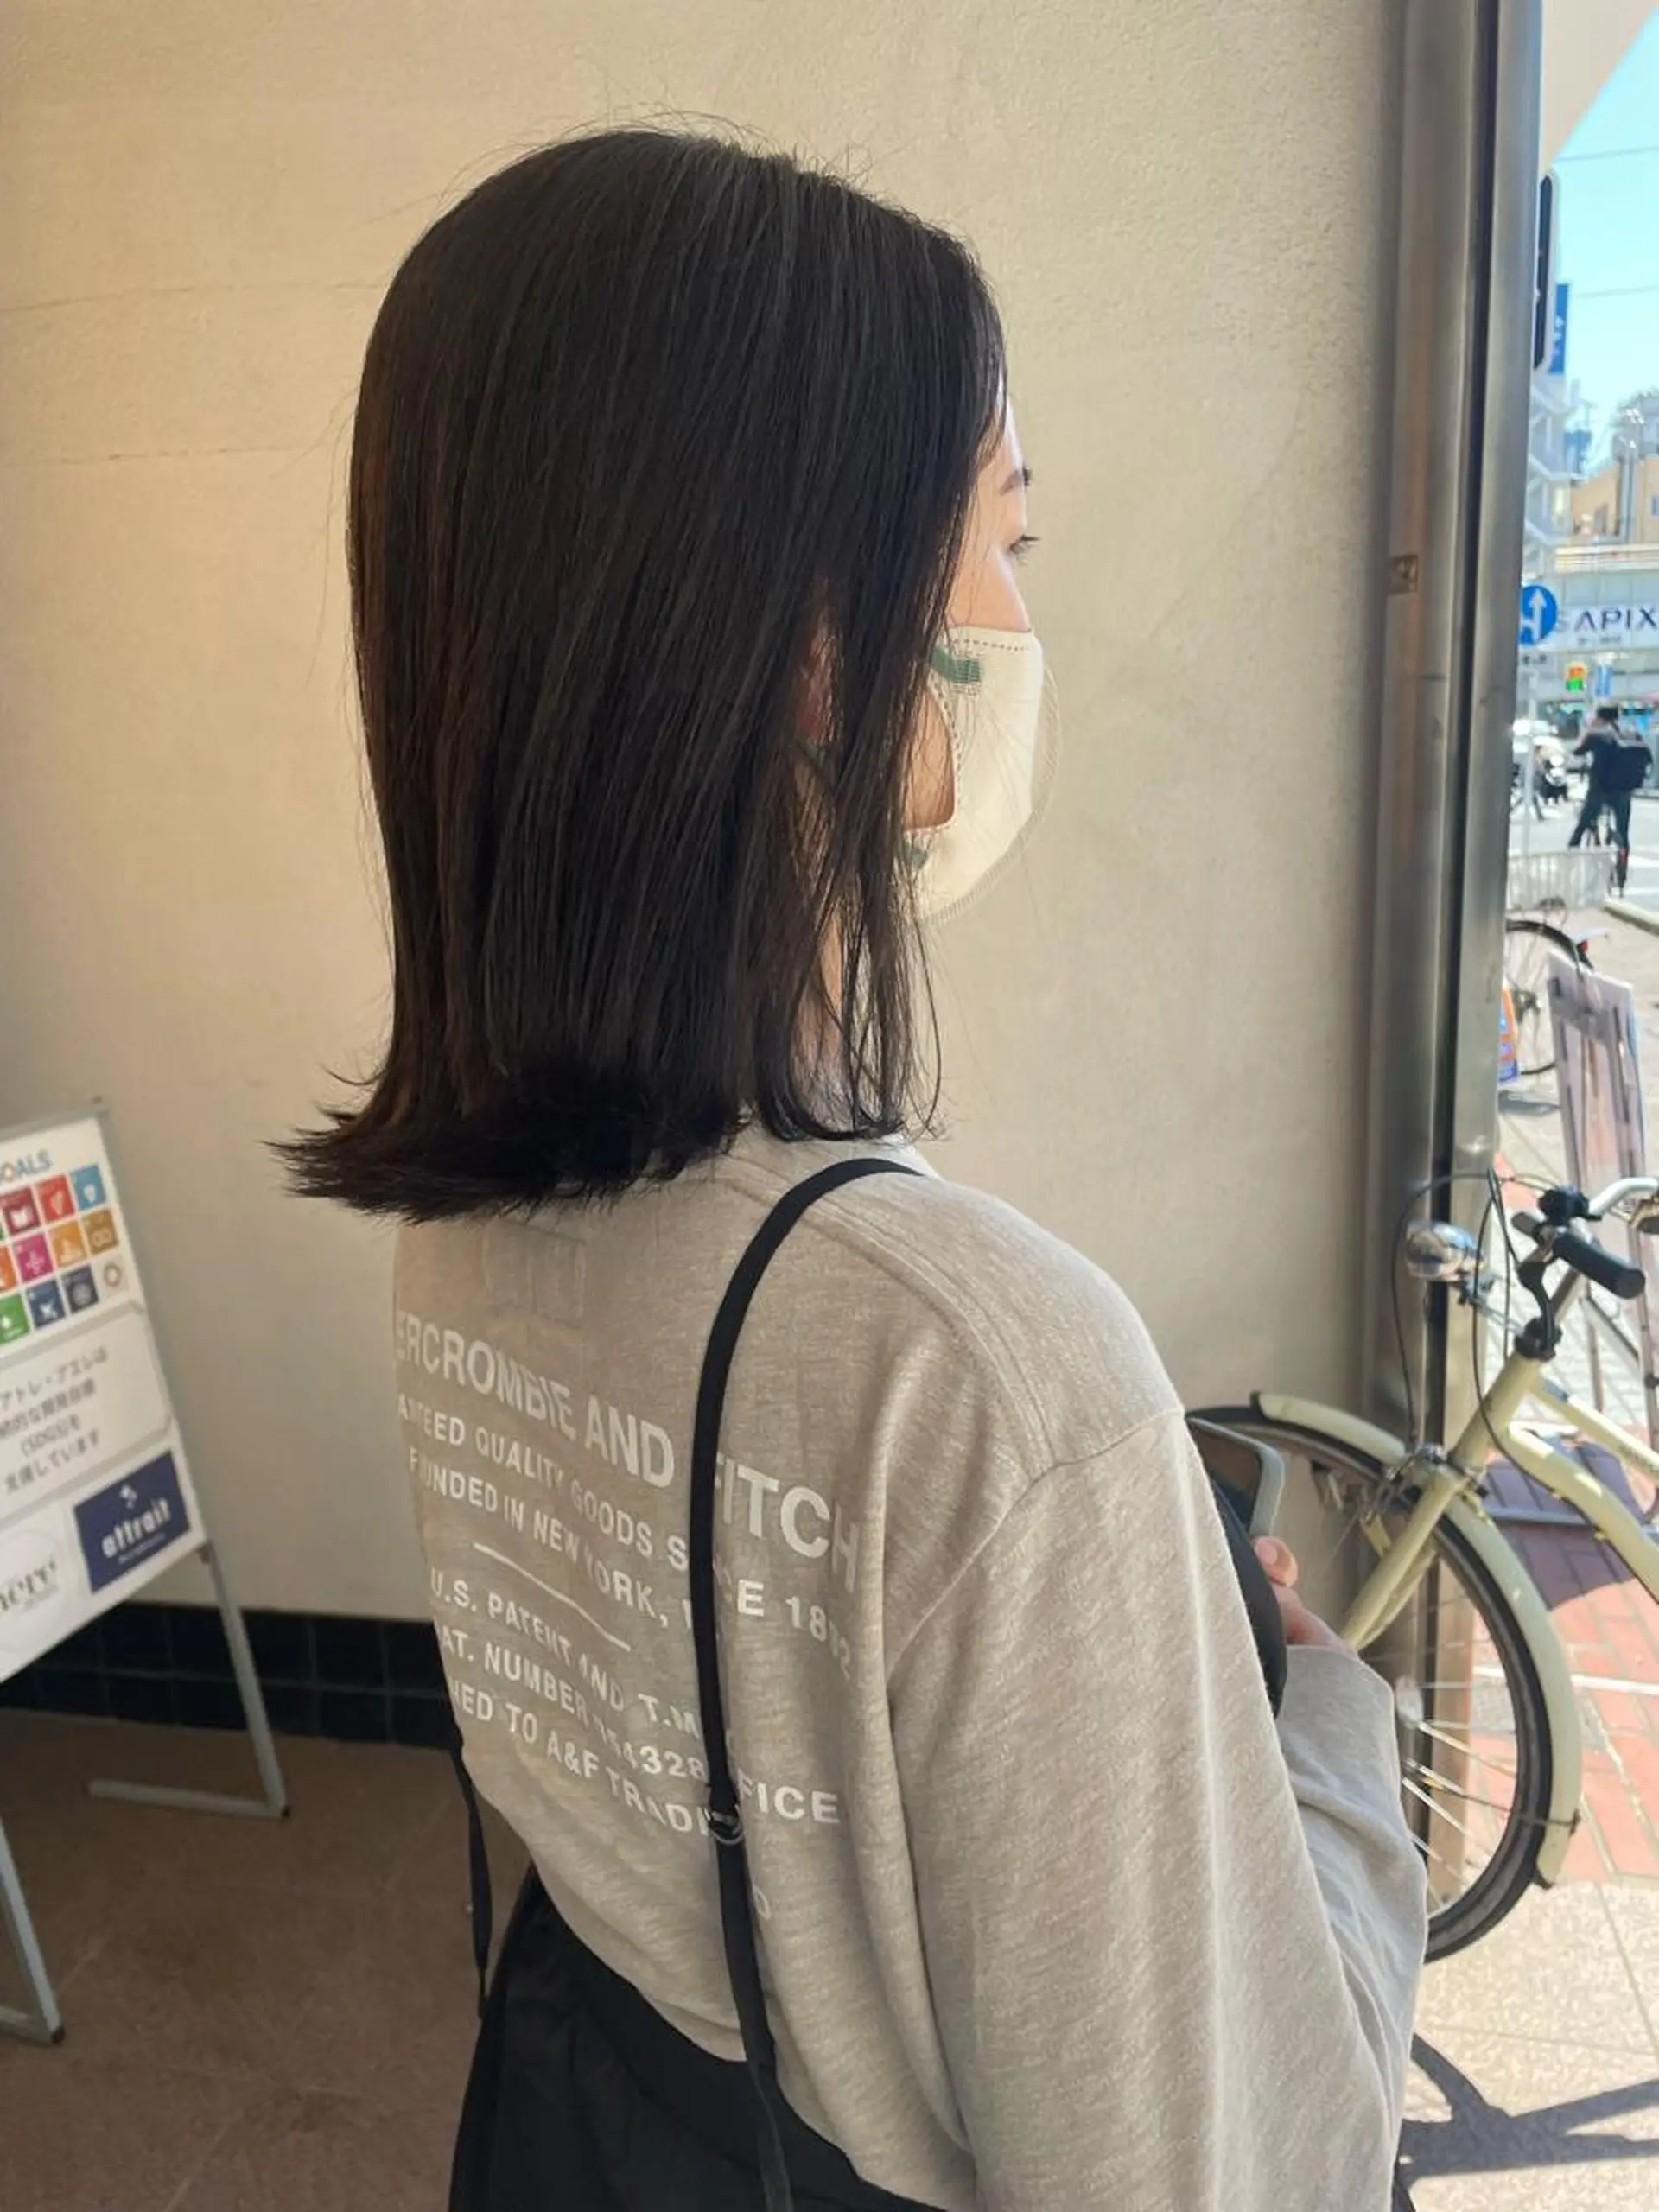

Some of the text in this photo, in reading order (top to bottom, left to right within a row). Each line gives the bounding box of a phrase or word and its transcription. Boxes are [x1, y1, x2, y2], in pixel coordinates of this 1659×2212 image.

[584, 1395, 675, 1488] AND
[504, 1495, 525, 1532] IN
[533, 1510, 581, 1564] NEW
[570, 1479, 653, 1557] GOODS
[484, 1641, 590, 1729] NUMBER
[505, 1702, 538, 1745] TO
[546, 1729, 600, 1779] A&F
